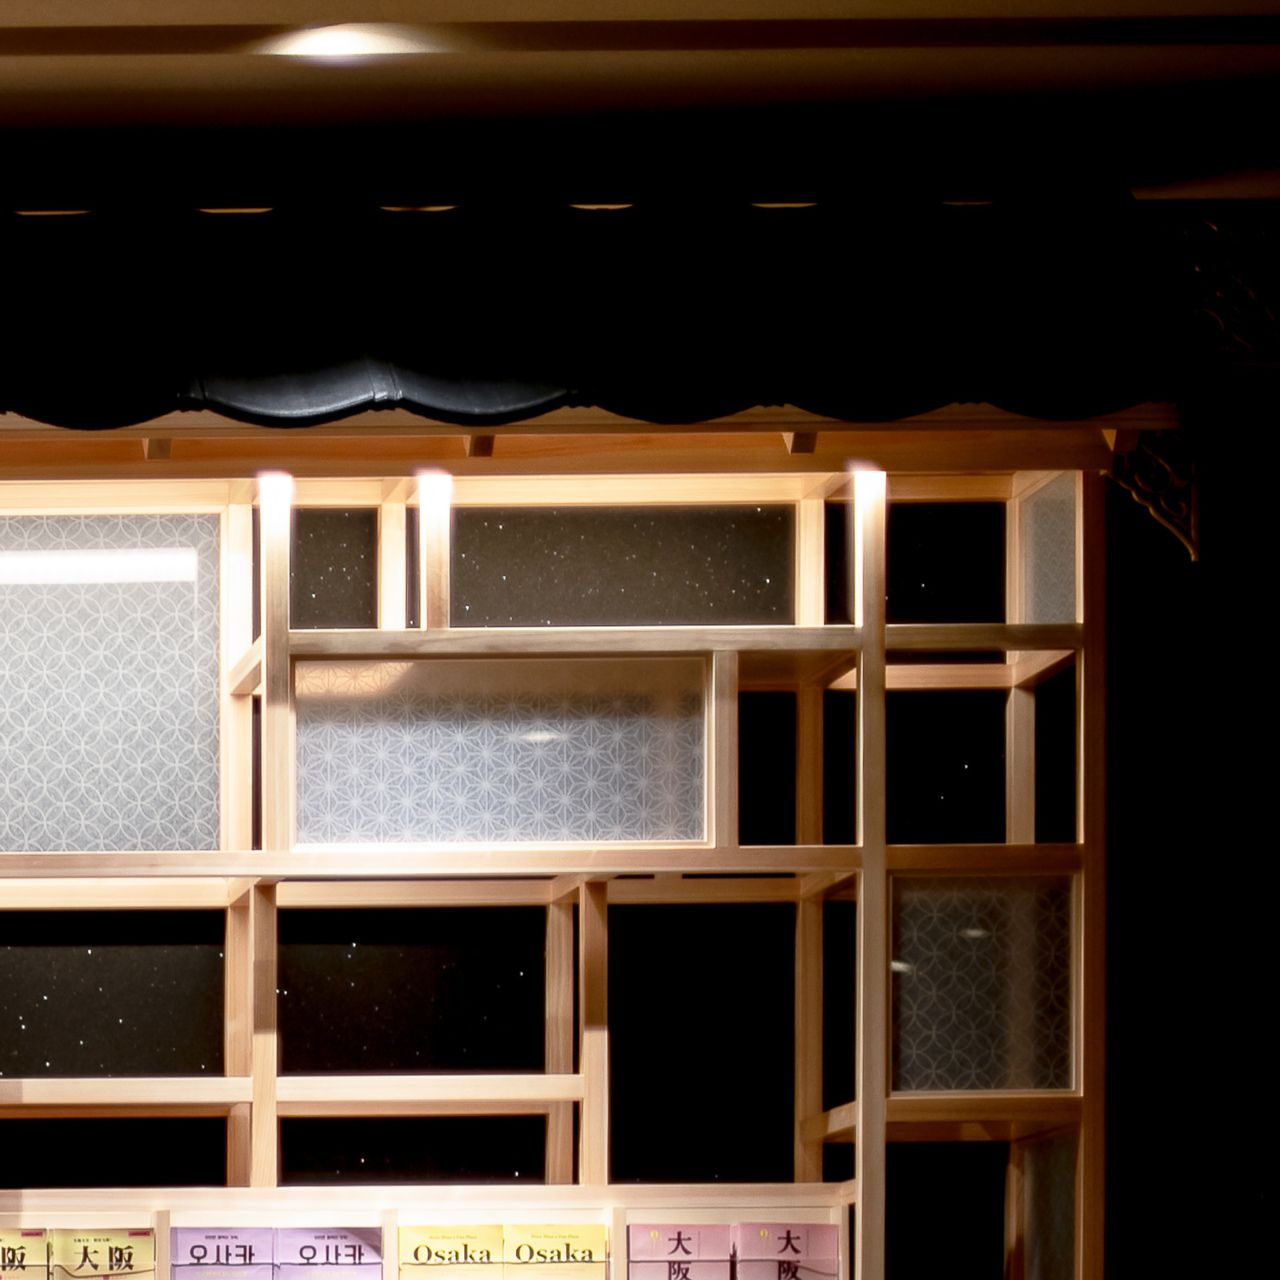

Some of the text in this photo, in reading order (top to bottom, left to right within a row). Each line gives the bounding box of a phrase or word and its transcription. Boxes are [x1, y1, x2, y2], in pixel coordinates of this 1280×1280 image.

[73, 1245, 134, 1272] 大阪
[190, 1244, 255, 1265] 오사카
[298, 1244, 365, 1265] 오사카
[413, 1243, 494, 1264] Osaka
[515, 1243, 595, 1263] Osaka
